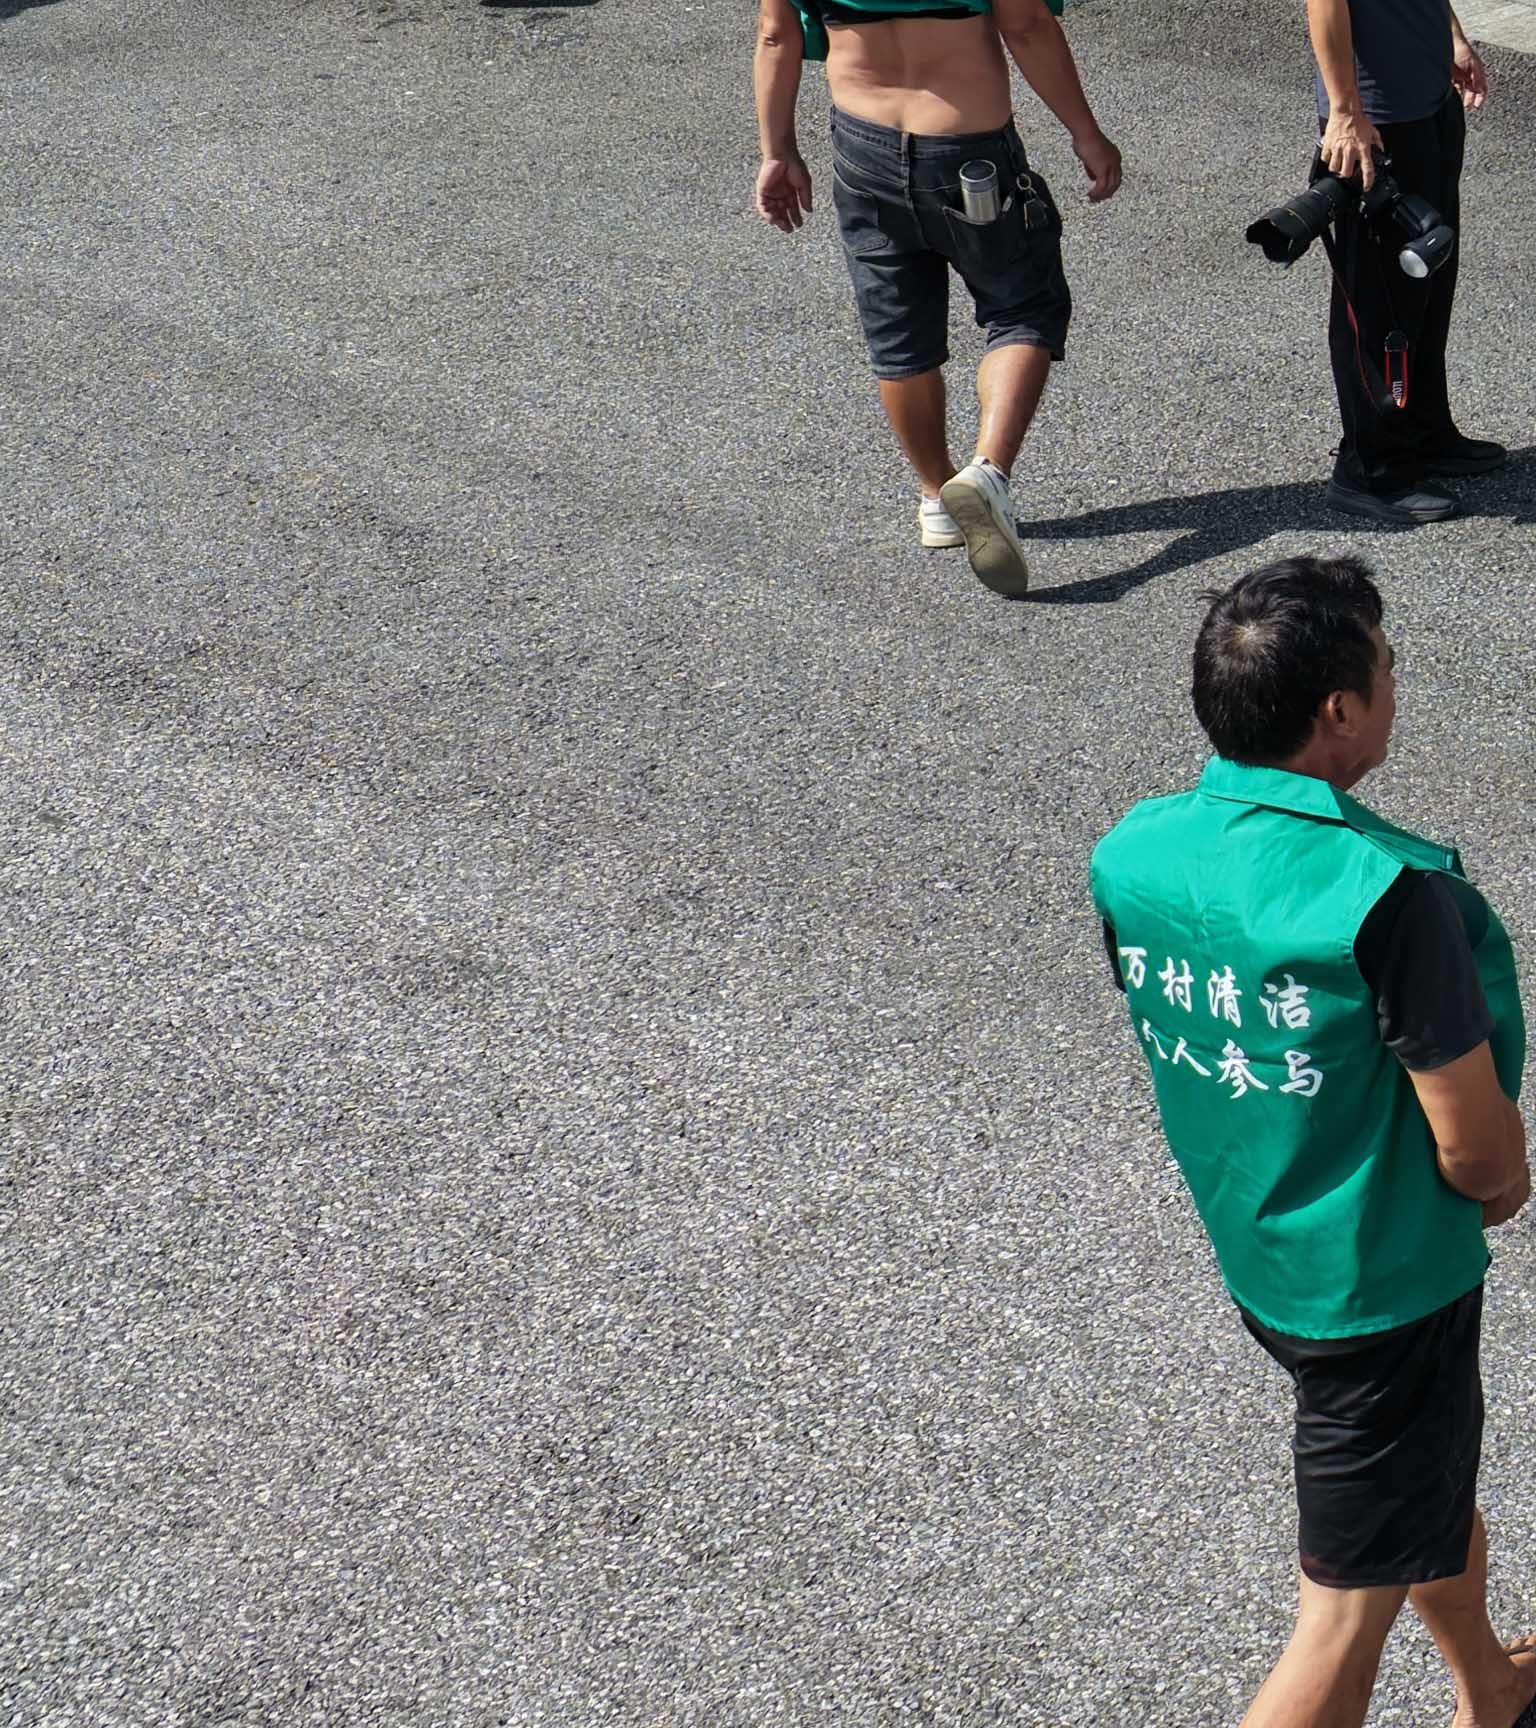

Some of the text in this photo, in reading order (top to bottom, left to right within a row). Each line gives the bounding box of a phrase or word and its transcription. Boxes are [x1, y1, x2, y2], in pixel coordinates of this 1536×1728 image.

[1117, 946, 1311, 1030] 万村清洁
[1140, 1020, 1325, 1100] 人人参与
